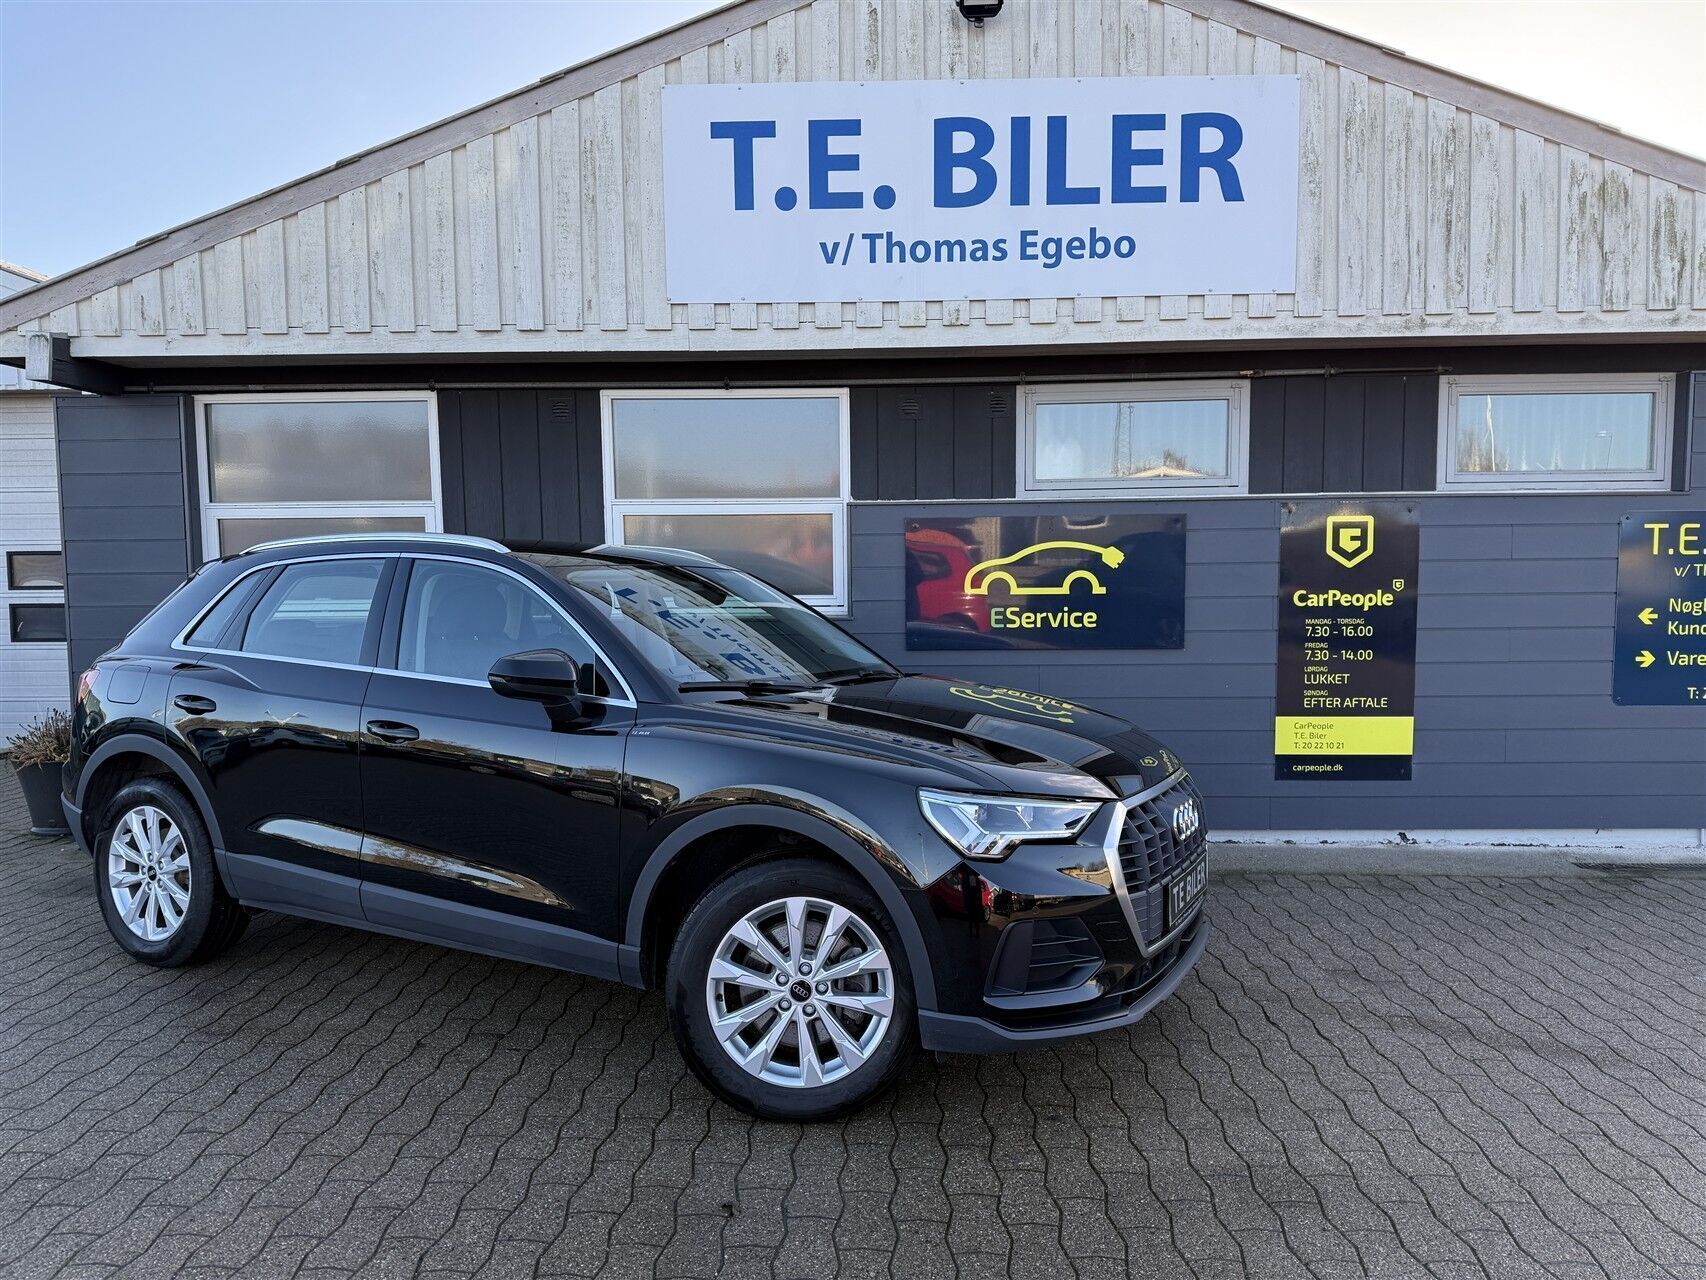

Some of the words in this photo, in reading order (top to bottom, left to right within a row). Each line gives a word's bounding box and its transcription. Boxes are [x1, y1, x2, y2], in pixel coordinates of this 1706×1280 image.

[710, 118, 897, 212] T.E.
[932, 111, 1246, 209] BILER
[819, 233, 854, 267] v/
[862, 231, 1009, 265] Thomas
[1019, 227, 1137, 269] Egebo
[1674, 563, 1691, 578] v/
[1693, 563, 1706, 577] T
[1293, 589, 1394, 611] CarPeople
[990, 606, 1098, 629] EService
[1305, 625, 1330, 637] 7.30
[1341, 625, 1374, 637] 16.00
[1304, 649, 1329, 661] 7.30
[1340, 649, 1374, 661] 14.00
[1304, 673, 1350, 685] LUKKET
[1687, 686, 1700, 699] T:
[1303, 697, 1341, 708] EFTER
[1343, 697, 1388, 708] AFTALE
[1294, 722, 1334, 731] CarPeople
[1294, 732, 1307, 740] T.E.
[1309, 732, 1327, 740] Biler
[1294, 741, 1301, 749] T:
[1302, 741, 1313, 749] 20
[1314, 741, 1324, 749] 22
[1325, 741, 1335, 749] 10
[1336, 741, 1345, 749] 21
[1292, 764, 1343, 772] carpeople.dk
[1172, 880, 1185, 914] TE
[1185, 861, 1206, 903] BILER
